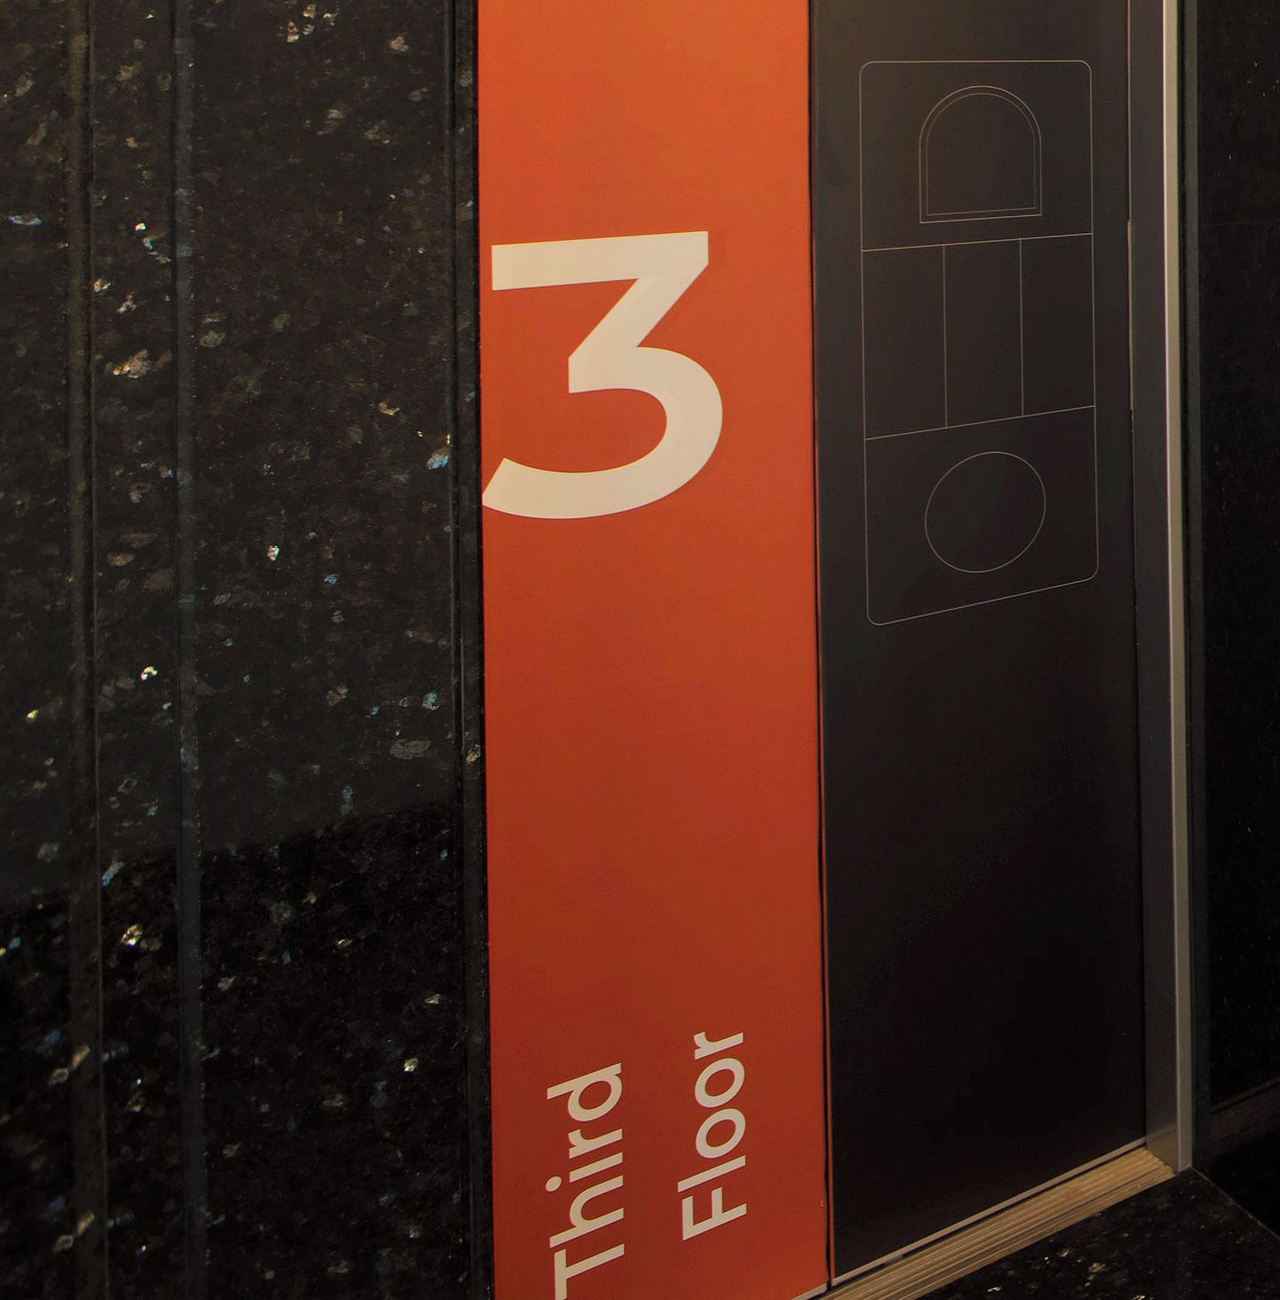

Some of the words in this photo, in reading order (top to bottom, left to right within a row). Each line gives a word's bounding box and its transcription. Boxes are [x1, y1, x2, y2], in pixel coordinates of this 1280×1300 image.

[481, 230, 723, 520] 3
[545, 1062, 625, 1300] Third
[677, 1031, 747, 1241] Floor
